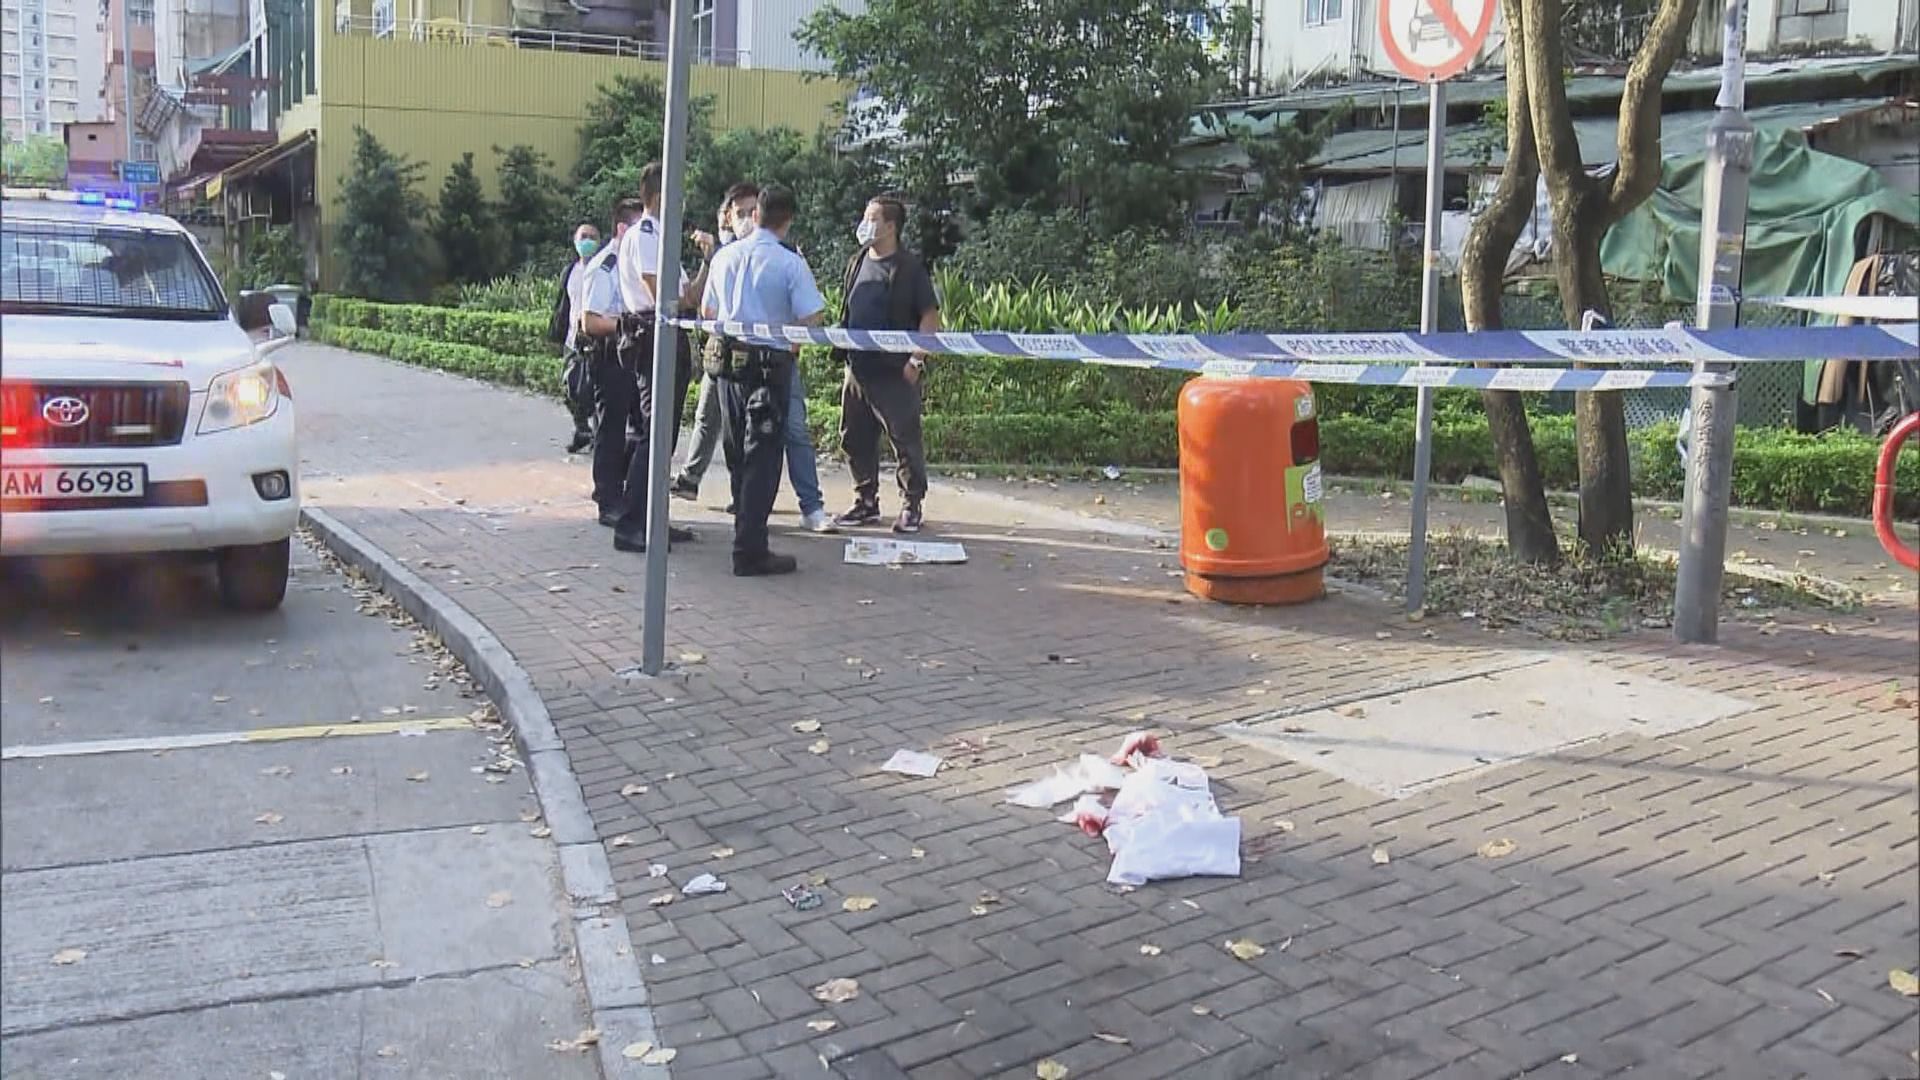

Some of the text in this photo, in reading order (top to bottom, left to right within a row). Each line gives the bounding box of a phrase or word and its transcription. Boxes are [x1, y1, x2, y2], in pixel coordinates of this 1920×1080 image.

[1286, 340, 1416, 355] POLICE CORDON
[4, 470, 135, 495] AM 6698
